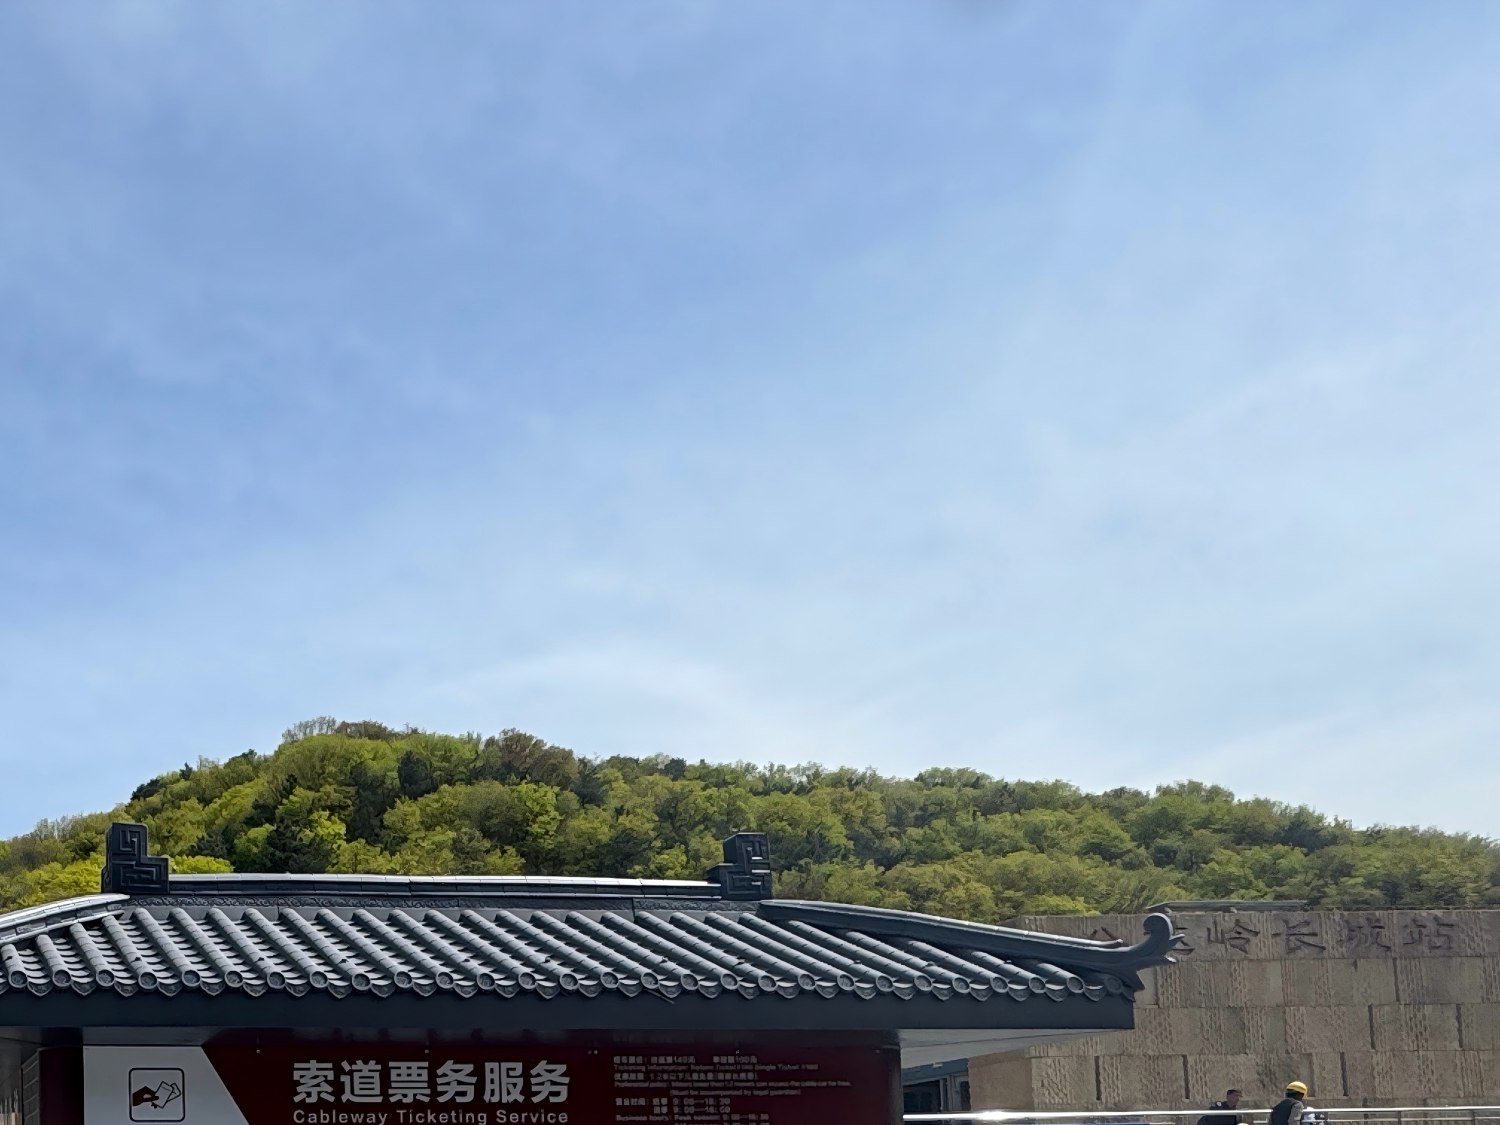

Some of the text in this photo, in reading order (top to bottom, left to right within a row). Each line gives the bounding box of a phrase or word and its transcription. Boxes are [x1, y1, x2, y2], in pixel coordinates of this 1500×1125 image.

[292, 1059, 571, 1104] 索道票务服务
[496, 1109, 569, 1124] Service
